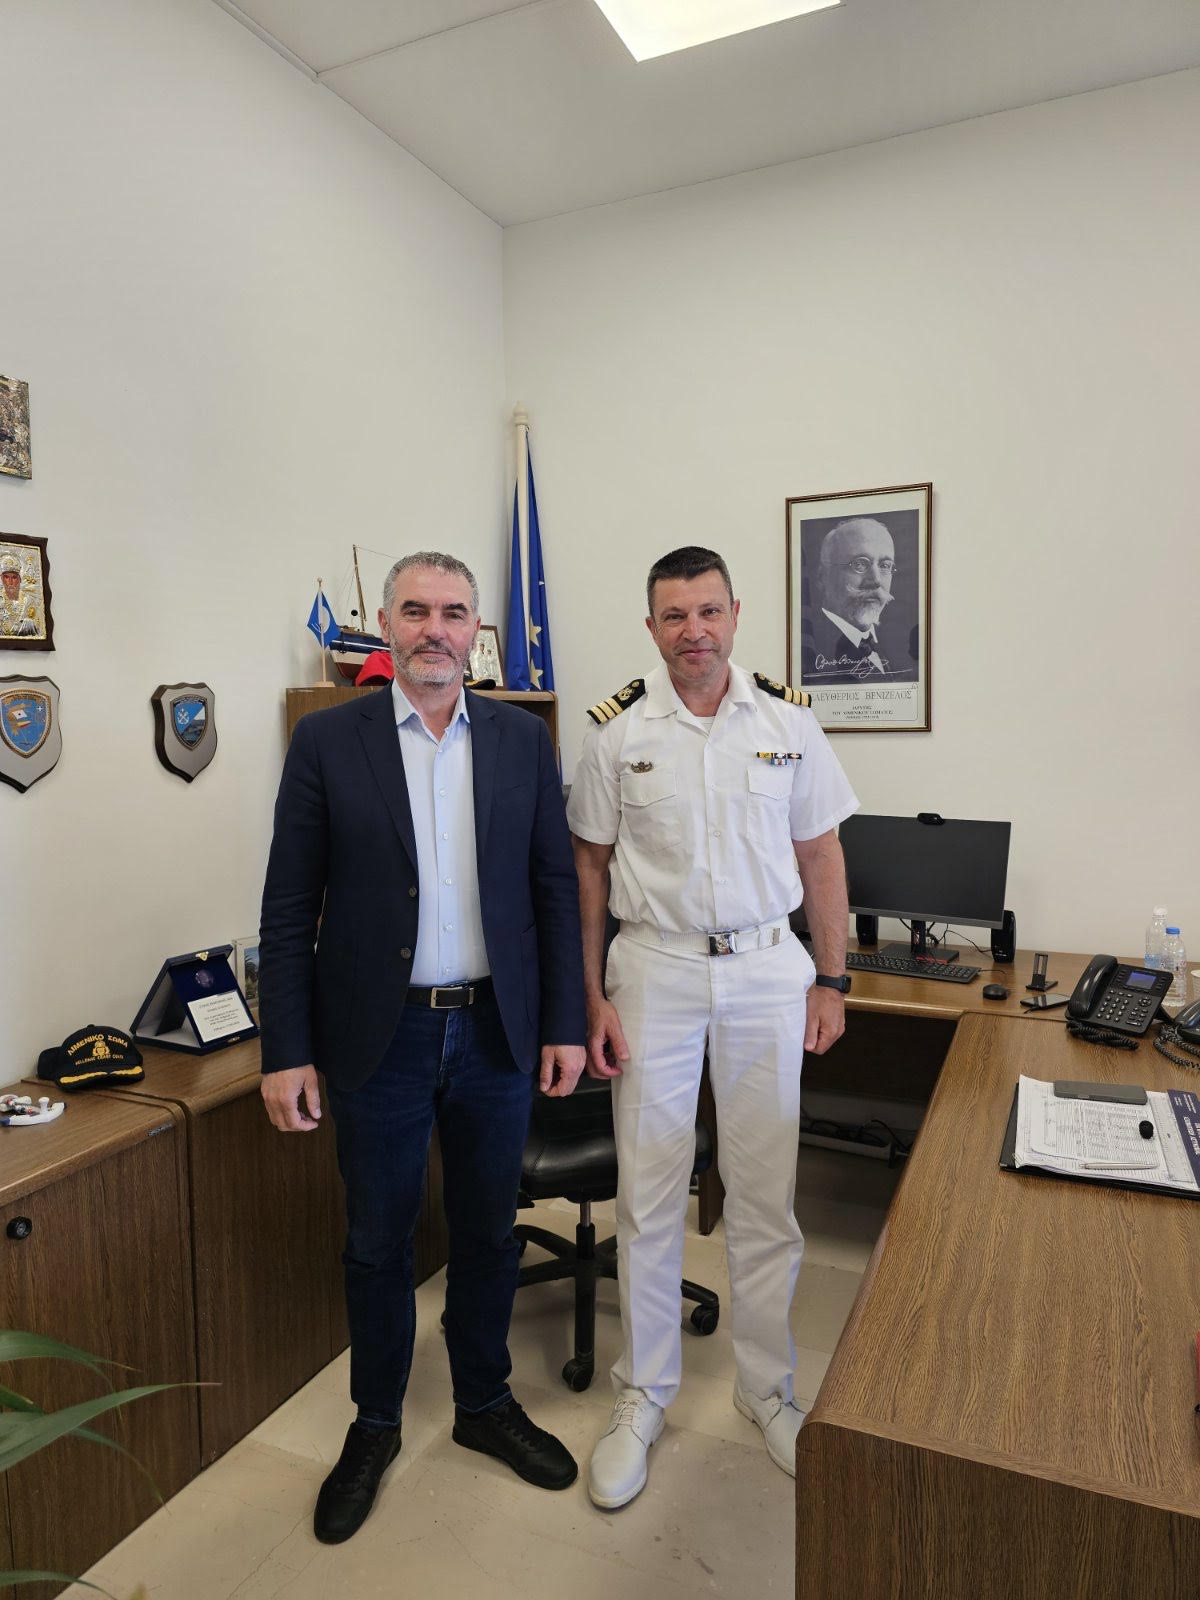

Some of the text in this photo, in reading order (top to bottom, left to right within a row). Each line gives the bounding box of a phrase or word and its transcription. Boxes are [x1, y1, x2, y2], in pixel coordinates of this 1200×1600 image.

[865, 690, 912, 700] ΒΕΝΙΖΕΛΟΣ
[67, 1034, 128, 1056] ΛΙΜΕΝΙΚΟ ΣΩΜΑ
